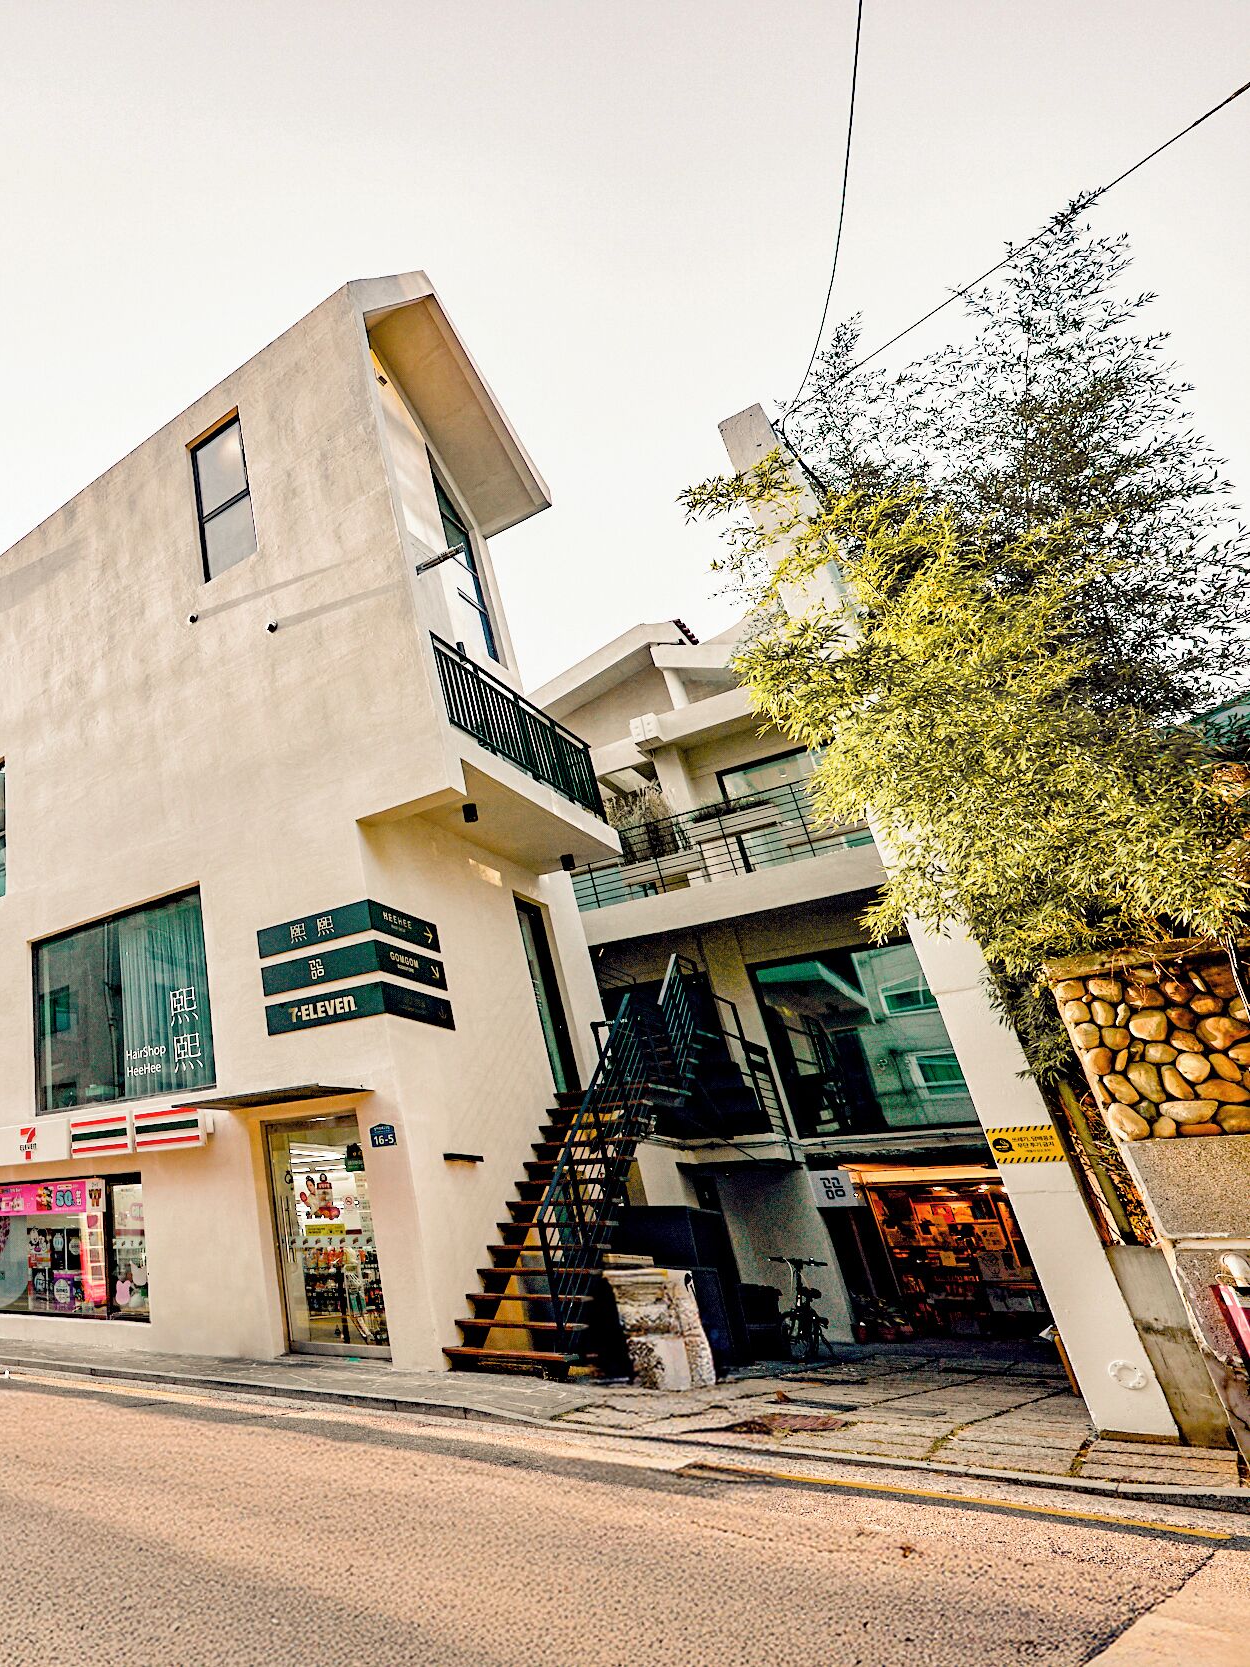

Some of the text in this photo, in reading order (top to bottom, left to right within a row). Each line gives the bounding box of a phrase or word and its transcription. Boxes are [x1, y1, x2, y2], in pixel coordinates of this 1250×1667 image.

[382, 911, 413, 930] HEEHEE
[390, 951, 420, 969] GOMGOM
[125, 1045, 167, 1061] HairShop
[126, 1063, 162, 1078] HeeHee
[373, 1134, 395, 1146] 16-5
